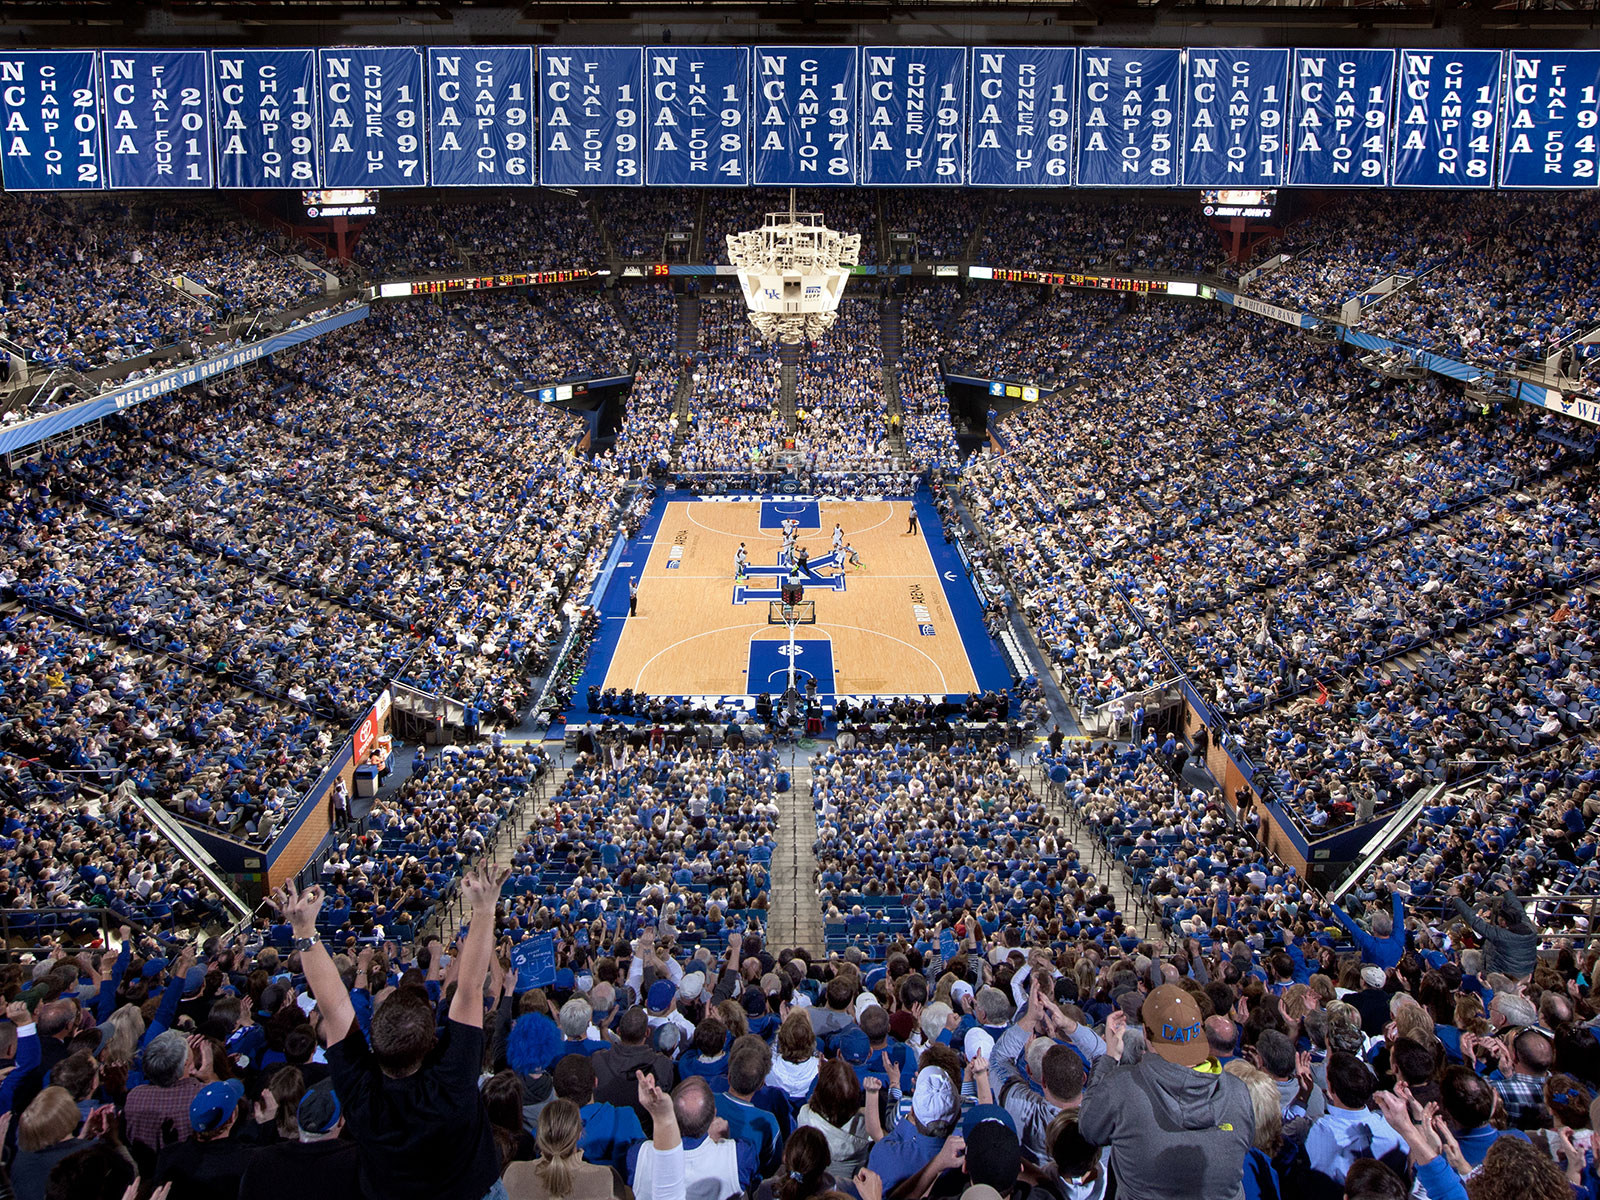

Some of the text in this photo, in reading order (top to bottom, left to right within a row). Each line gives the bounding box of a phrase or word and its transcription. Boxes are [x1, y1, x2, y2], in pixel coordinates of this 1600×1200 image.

[0, 62, 31, 156] NCAA
[40, 66, 62, 174] CHAMPION
[73, 89, 97, 182] 2012
[110, 60, 138, 153] NCAA
[152, 66, 173, 174] FINAL FOUR
[181, 88, 202, 180] 2011
[220, 59, 247, 154] NCAA
[259, 66, 281, 177] CHAMPION
[291, 87, 313, 180] 1998
[327, 58, 353, 152] NCAA
[365, 66, 384, 173] RUNNER UP
[396, 86, 418, 176] 1997
[437, 57, 462, 150] NCAA
[475, 61, 496, 172] CHAMPION
[506, 83, 526, 175] 1996
[547, 57, 571, 151] NCAA
[583, 63, 602, 171] FINAL FOUR
[616, 85, 636, 176] 1993
[653, 57, 678, 150] NCAA
[688, 63, 708, 170] FINAL FOUR
[720, 85, 741, 175] 1984
[761, 56, 787, 150] NCAA
[799, 60, 818, 171] CHAMPION
[828, 84, 849, 175] 1978
[869, 57, 895, 150] NCAA
[906, 64, 926, 170] RUNNER UP
[936, 83, 958, 175] 1975
[978, 54, 1005, 148] NCAA
[1016, 64, 1036, 171] RUNNER UP
[1046, 85, 1068, 176] 1966
[1085, 58, 1111, 151] NCAA
[1122, 62, 1142, 172] CHAMPION
[1150, 85, 1172, 176] 1958
[1191, 59, 1219, 154] NCAA
[1227, 61, 1249, 172] CHAMPION
[1259, 85, 1280, 176] 1951
[1298, 57, 1327, 152] NCAA
[1333, 62, 1356, 173] CHAMPION
[1362, 86, 1385, 177] 1949
[1402, 55, 1434, 150] NCAA
[1439, 63, 1463, 173] CHAMPION
[1466, 86, 1494, 177] 1948
[1509, 59, 1541, 153] NCAA
[1545, 65, 1566, 173] FINAL FOUR
[1573, 86, 1598, 177] 1942
[655, 265, 669, 275] 35
[1244, 299, 1296, 324] WHITAKER BANK
[115, 345, 264, 409] WELCOME TO RUPP ARENA
[908, 583, 932, 622] RUPP ARENA
[1161, 1021, 1201, 1042] CATS
